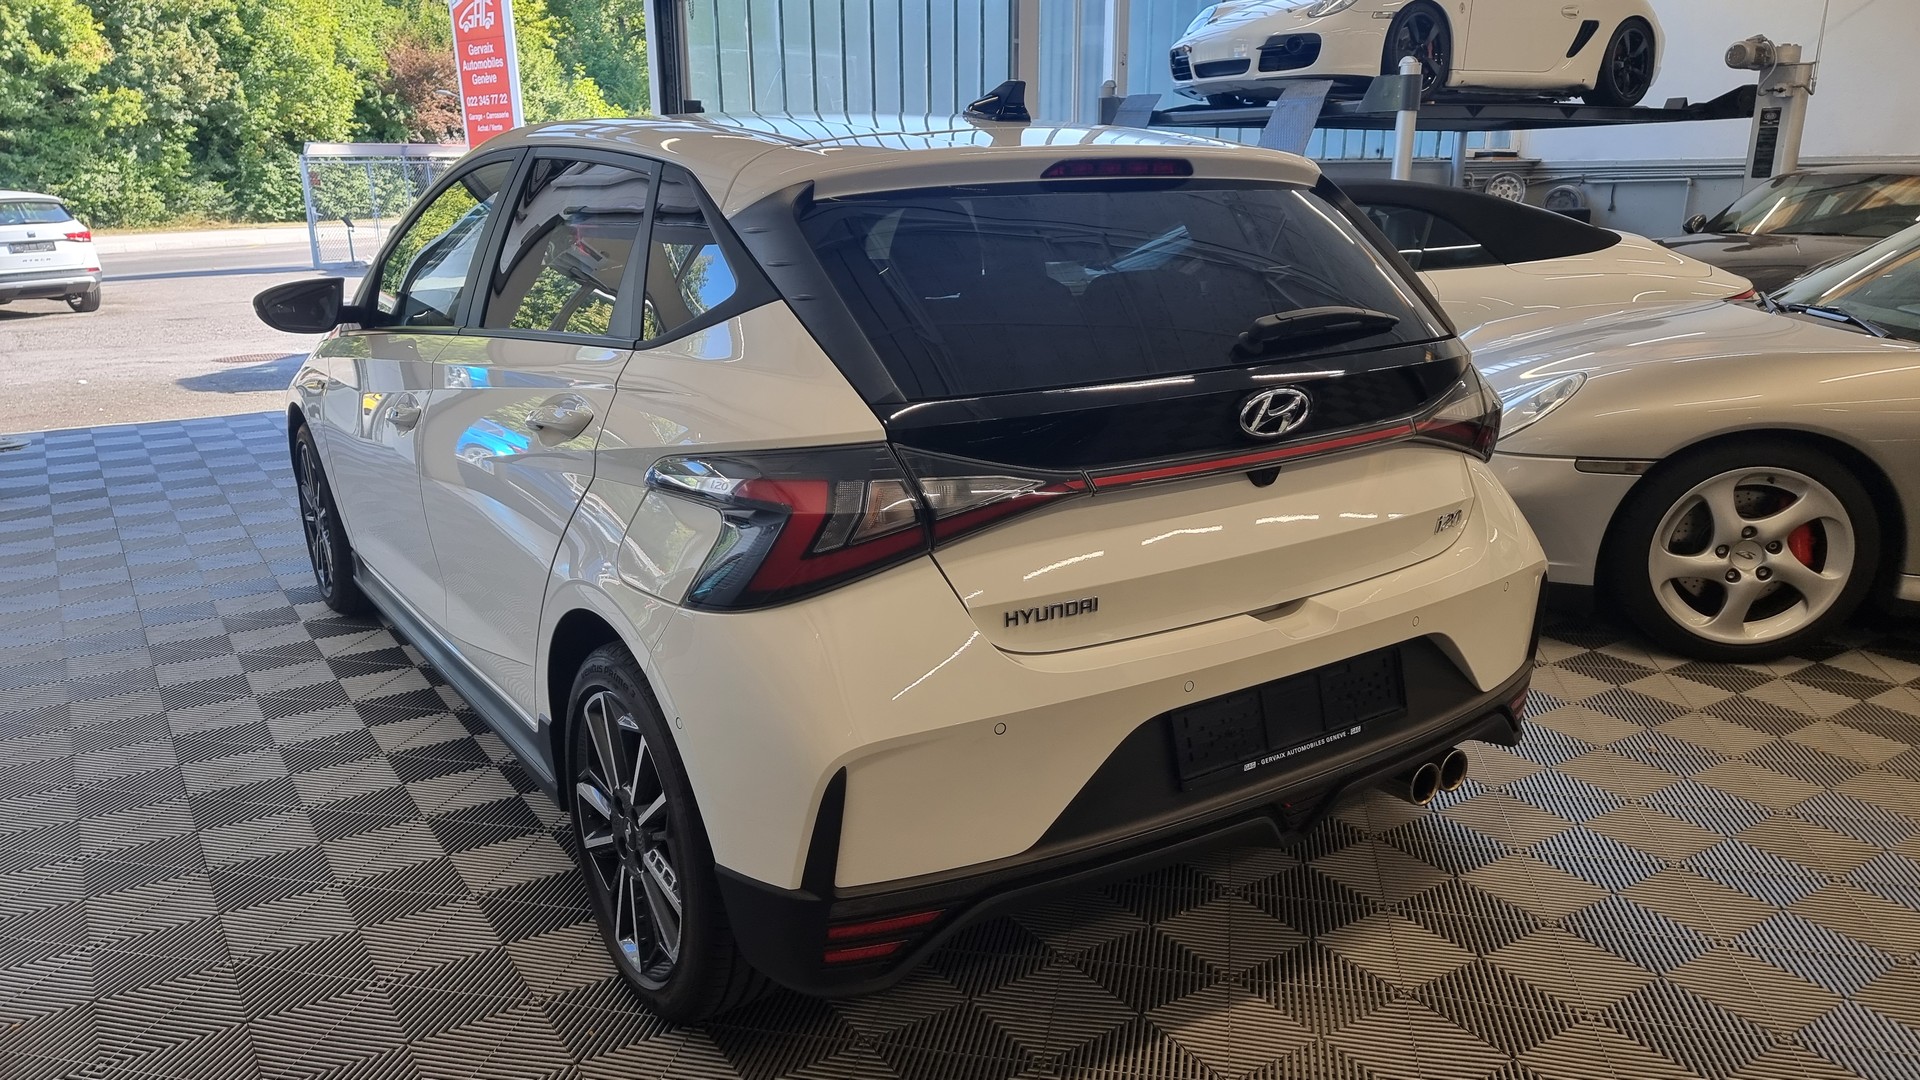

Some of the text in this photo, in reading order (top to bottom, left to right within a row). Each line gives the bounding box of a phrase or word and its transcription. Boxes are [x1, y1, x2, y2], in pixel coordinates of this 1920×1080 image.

[468, 42, 494, 56] Gervaix
[462, 57, 504, 71] Automobiles
[472, 72, 497, 85] Genève
[466, 92, 508, 107] 022 345 77 22
[1004, 595, 1099, 628] HYUNDAI
[1260, 752, 1286, 765] GERVAIX
[1286, 738, 1326, 757] AUTOMOBILES
